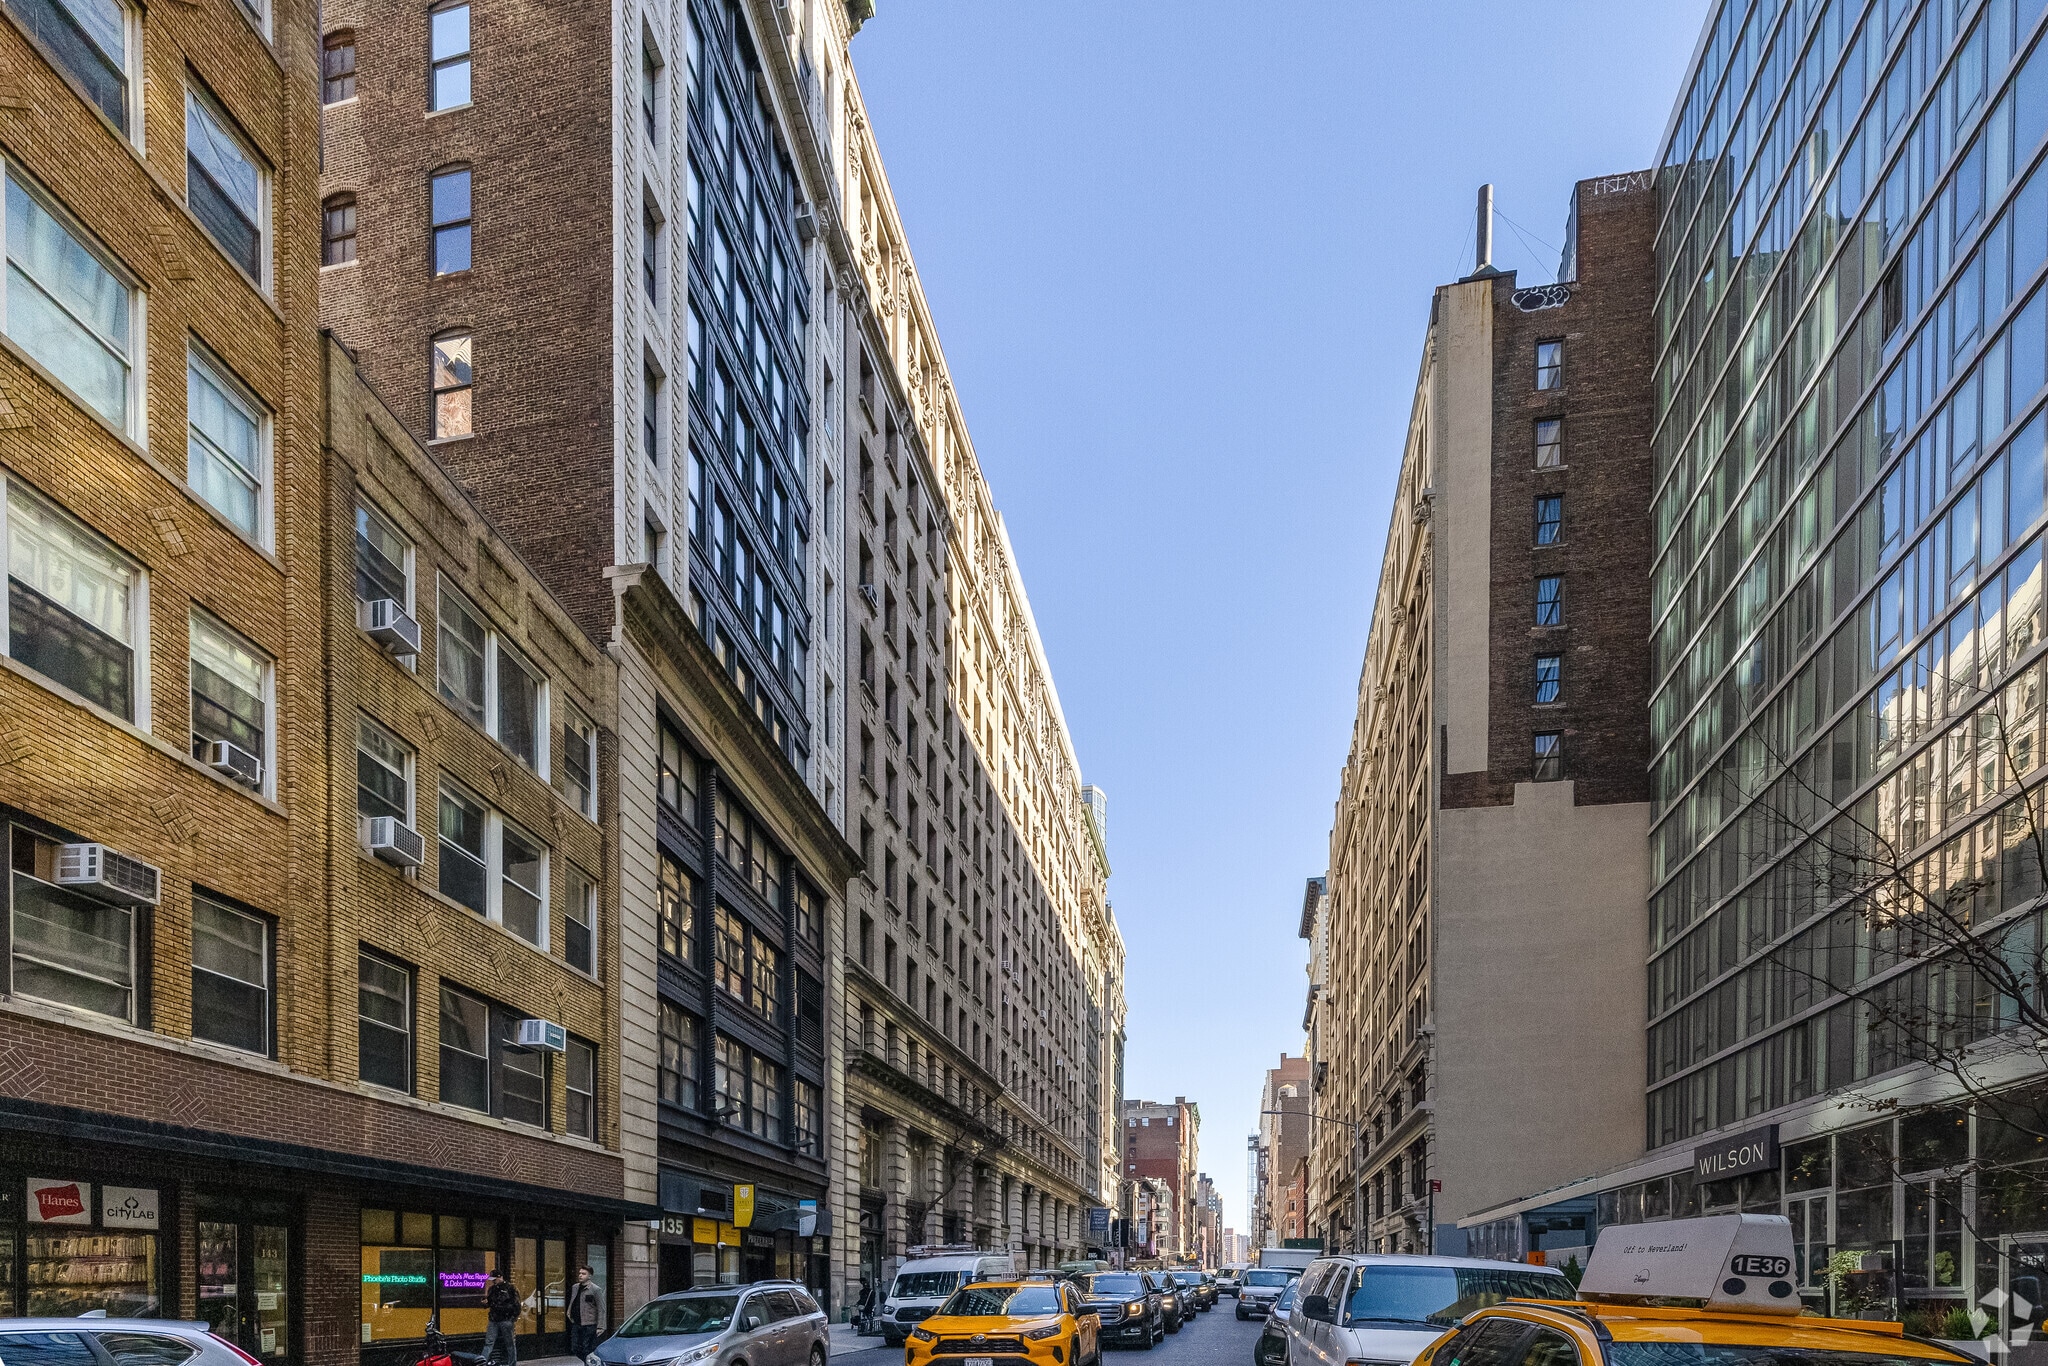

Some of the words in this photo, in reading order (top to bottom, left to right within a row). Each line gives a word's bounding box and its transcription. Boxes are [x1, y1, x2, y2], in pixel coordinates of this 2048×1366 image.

[1699, 1141, 1764, 1175] WILSON
[41, 1194, 79, 1207] Hanes
[660, 1218, 684, 1235] 135
[261, 1249, 278, 1258] 143
[1623, 1245, 1636, 1254] Off
[1637, 1246, 1646, 1254] to
[1647, 1243, 1688, 1253] Neverland!
[1735, 1257, 1788, 1275] 1E36
[363, 1275, 391, 1283] Phoebe's
[391, 1275, 409, 1283] Photo
[408, 1275, 427, 1283] Studio
[463, 1280, 486, 1289] Recovery
